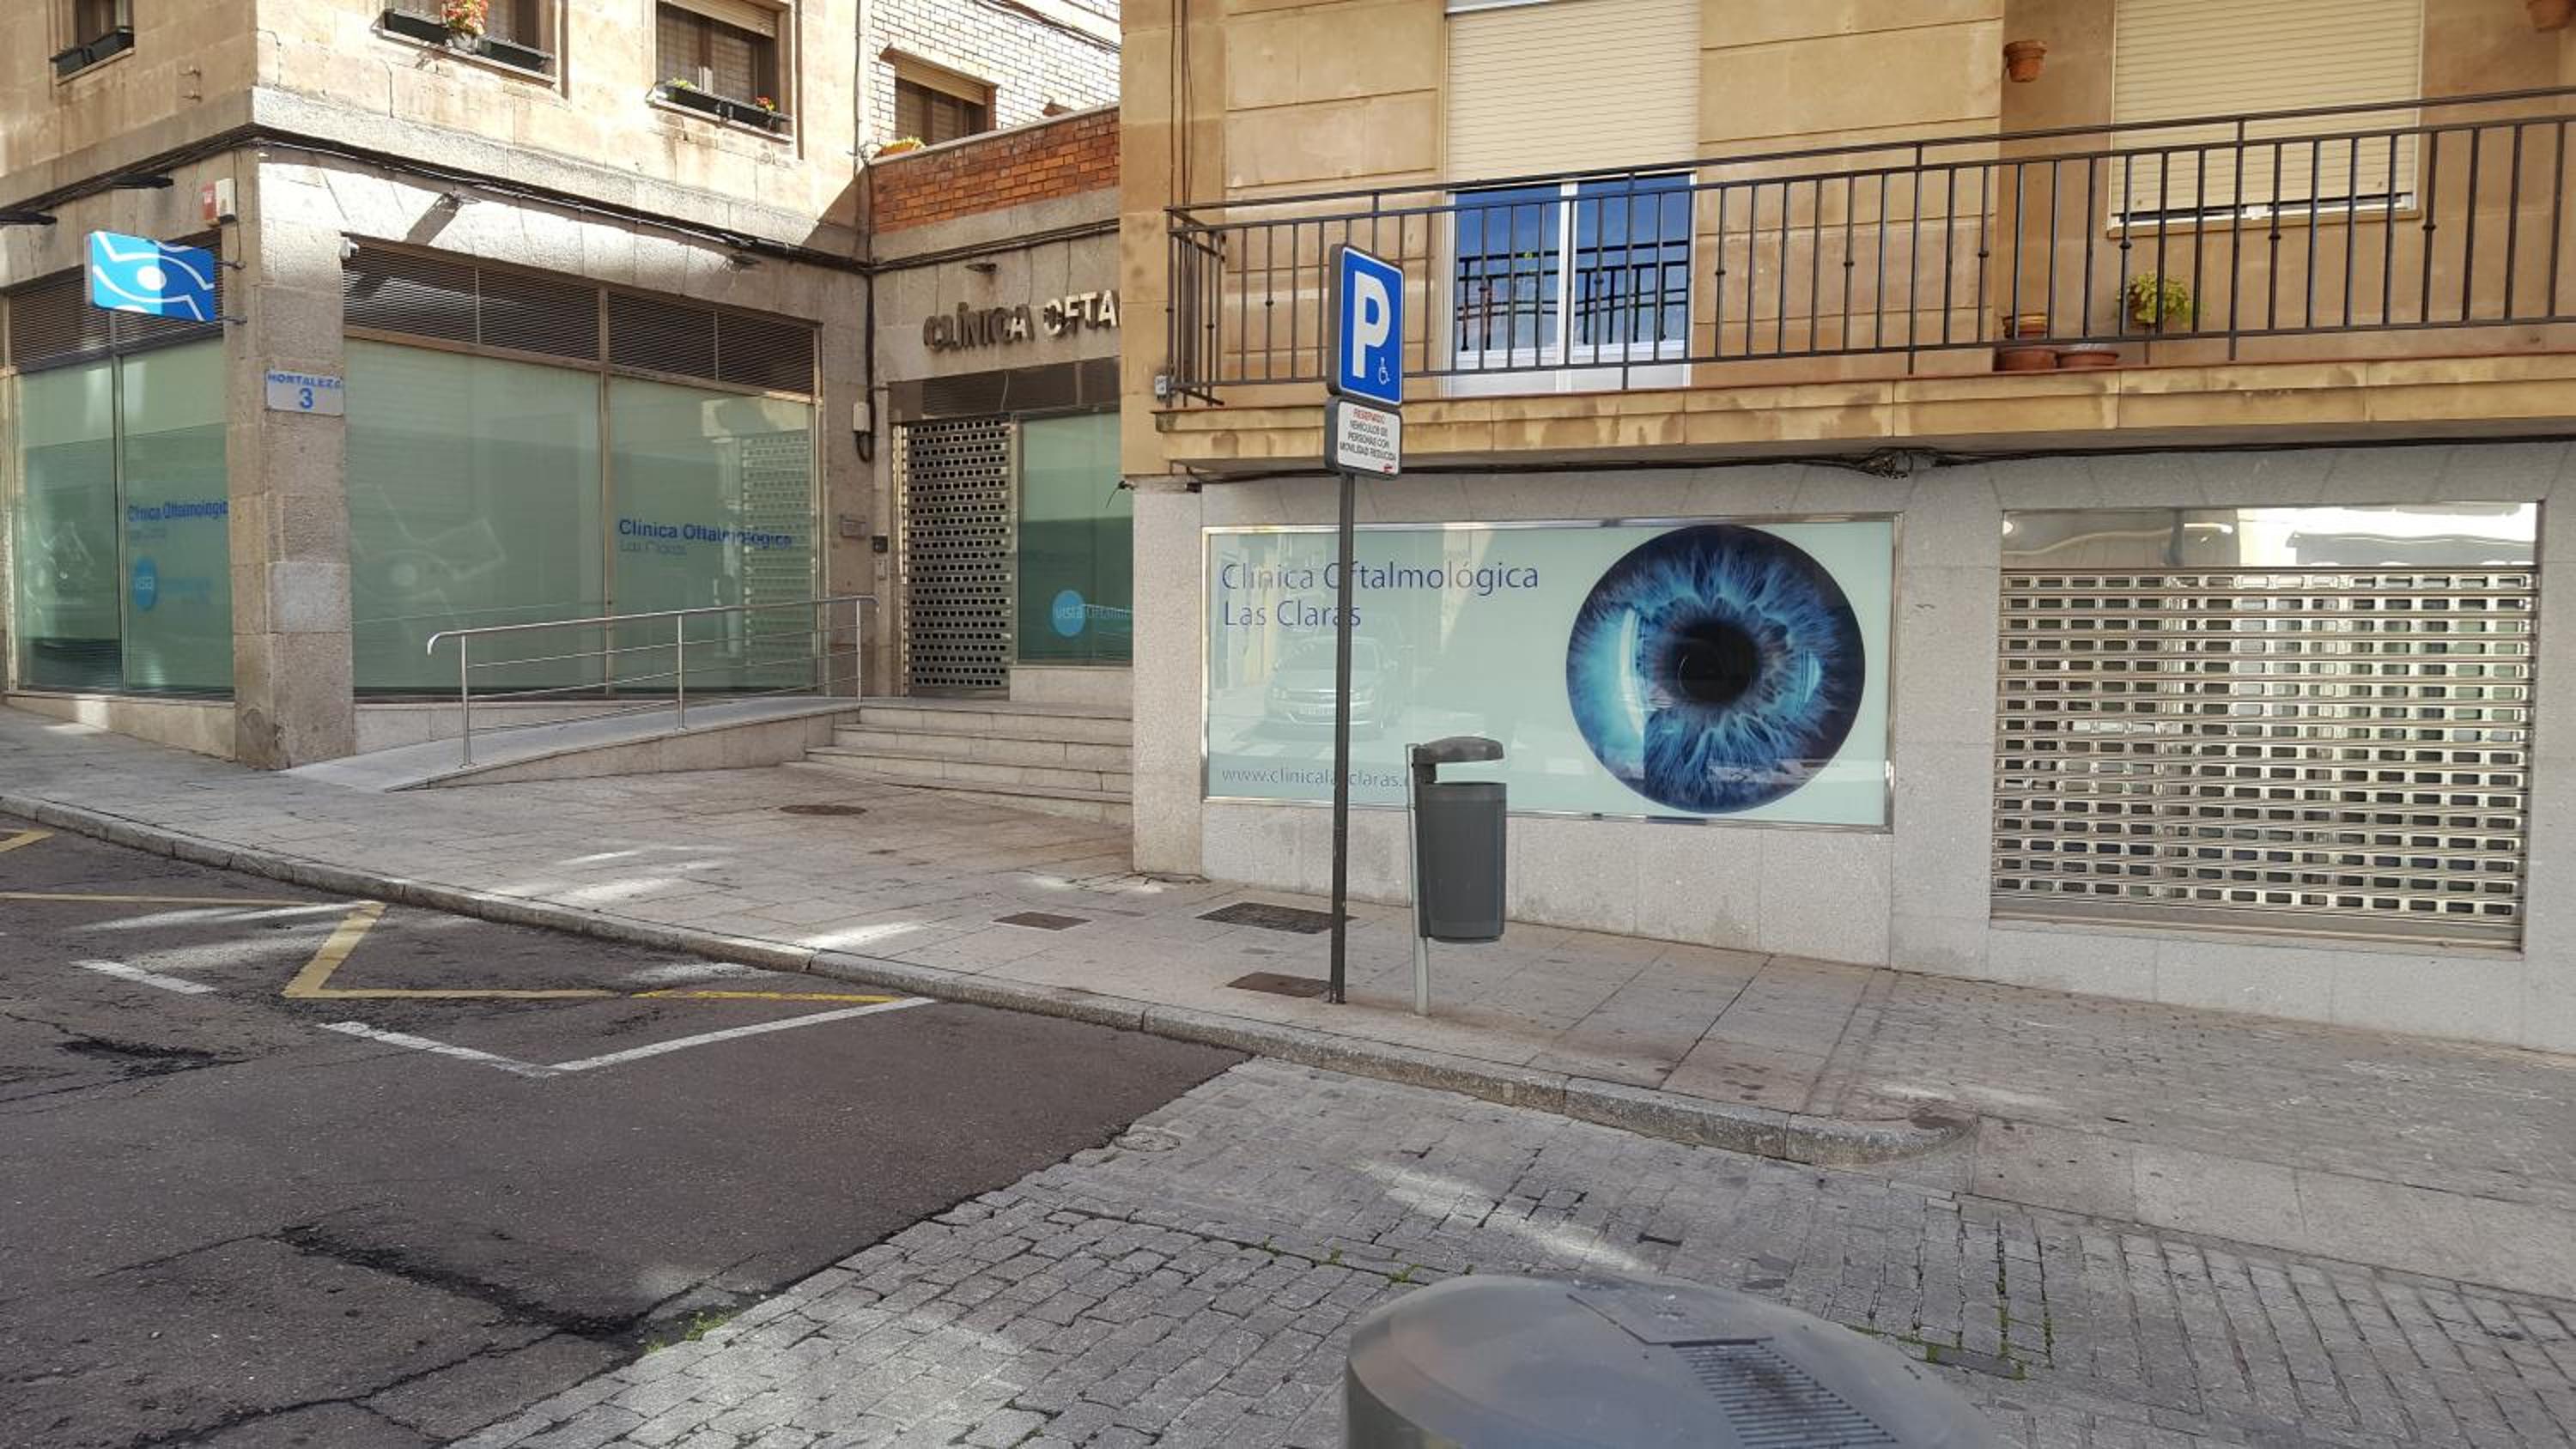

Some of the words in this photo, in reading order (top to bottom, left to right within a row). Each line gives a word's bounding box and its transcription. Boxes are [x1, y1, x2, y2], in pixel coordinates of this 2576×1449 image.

[1042, 288, 1122, 337] OFTA
[1352, 270, 1391, 379] P
[299, 387, 313, 409] 3
[1224, 601, 1267, 627] Las
